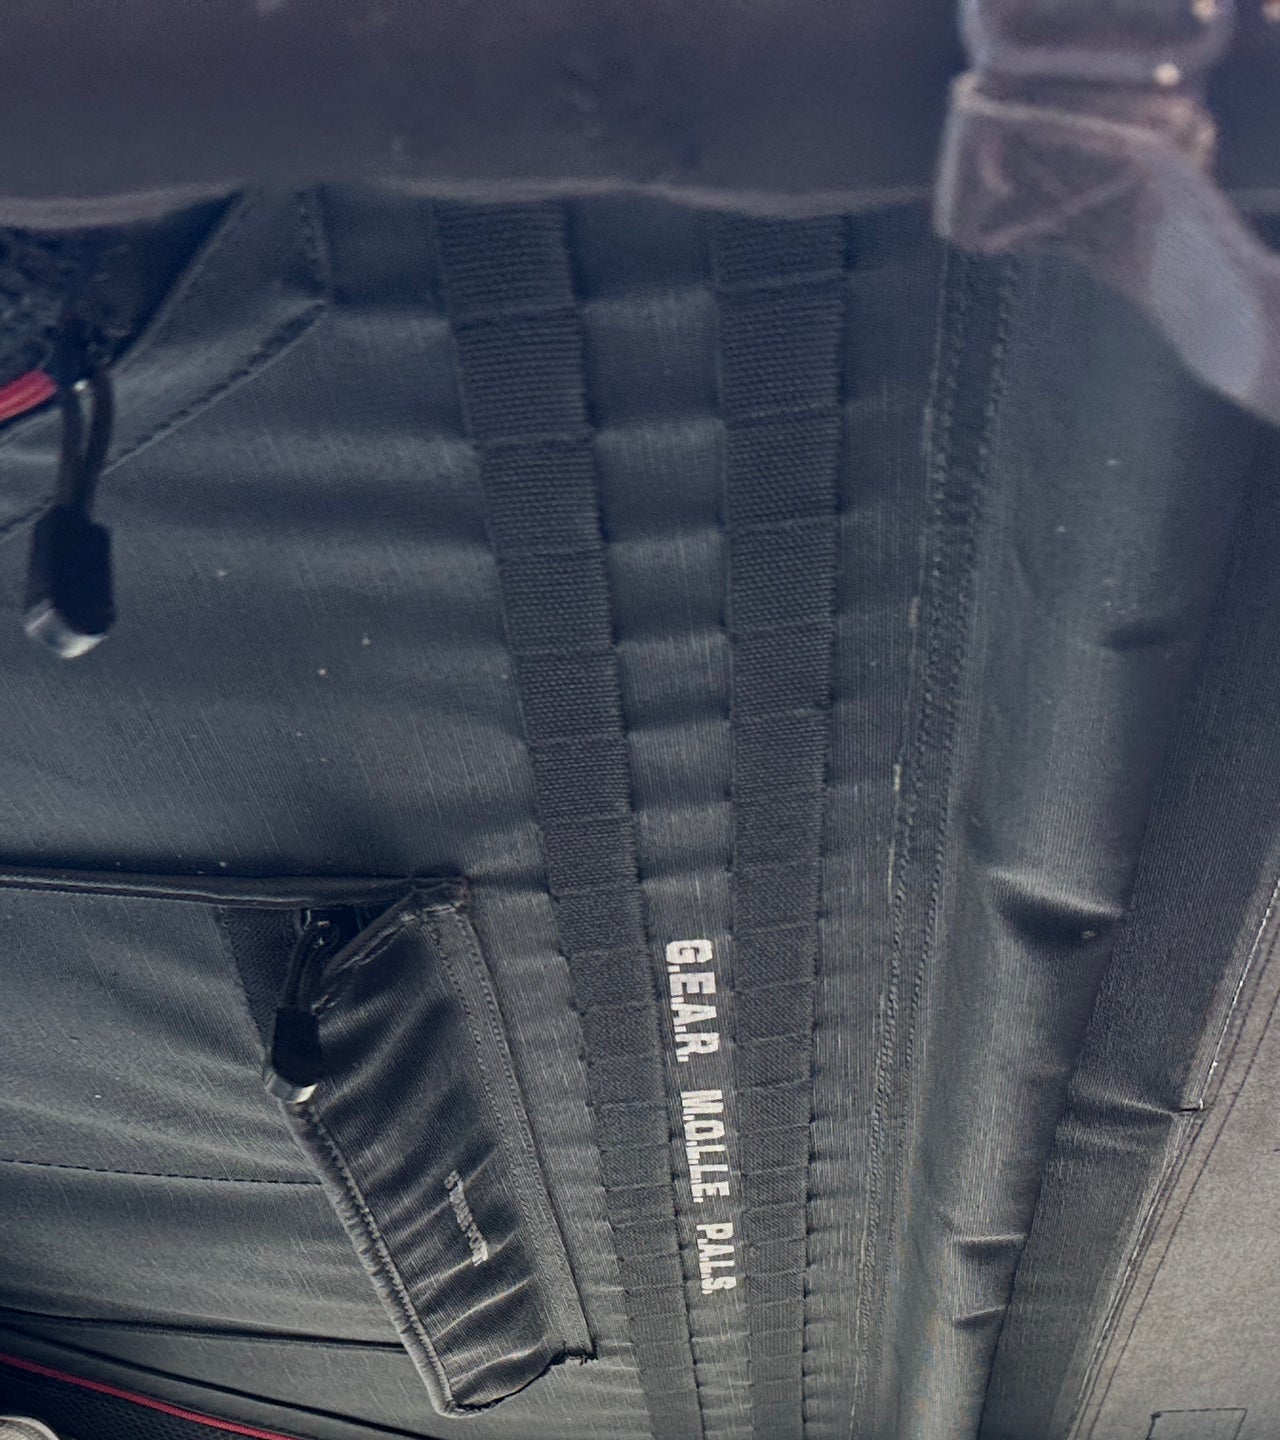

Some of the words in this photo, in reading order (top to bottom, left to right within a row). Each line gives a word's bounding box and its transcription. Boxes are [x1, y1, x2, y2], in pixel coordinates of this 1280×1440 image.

[665, 938, 720, 1062] G.E.A.R.
[680, 1088, 731, 1203] M.O.L.L.E.
[696, 1222, 737, 1295] P.A.L.S.
